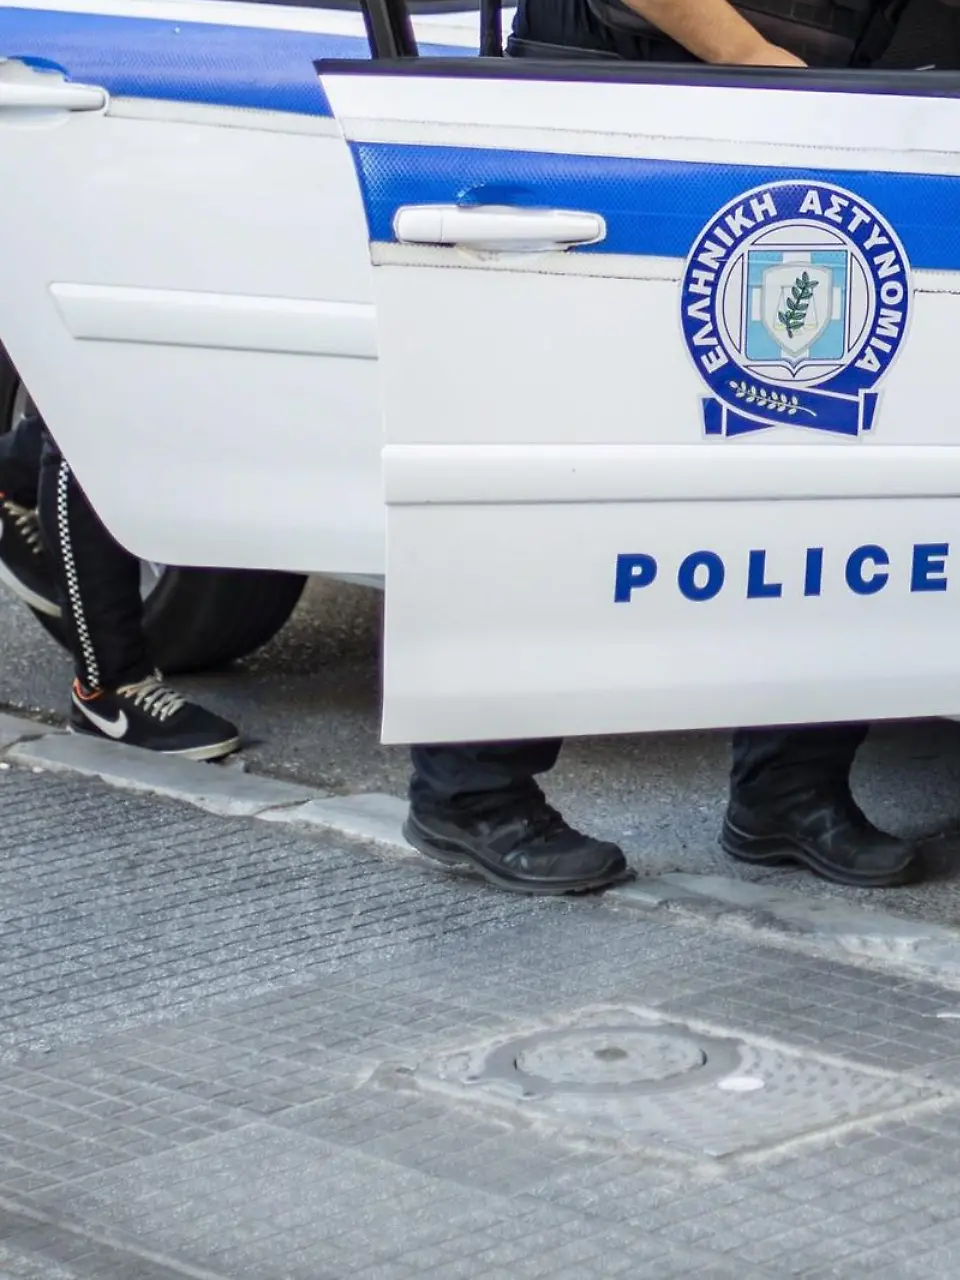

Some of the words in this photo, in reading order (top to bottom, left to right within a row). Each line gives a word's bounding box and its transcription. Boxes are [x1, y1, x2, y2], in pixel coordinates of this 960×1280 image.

[687, 192, 779, 375] ΕΛΛΗΝΙΚΗ
[799, 189, 905, 373] ΑΣΤΥΝΟΜΙΑ
[614, 542, 950, 604] POLICE
